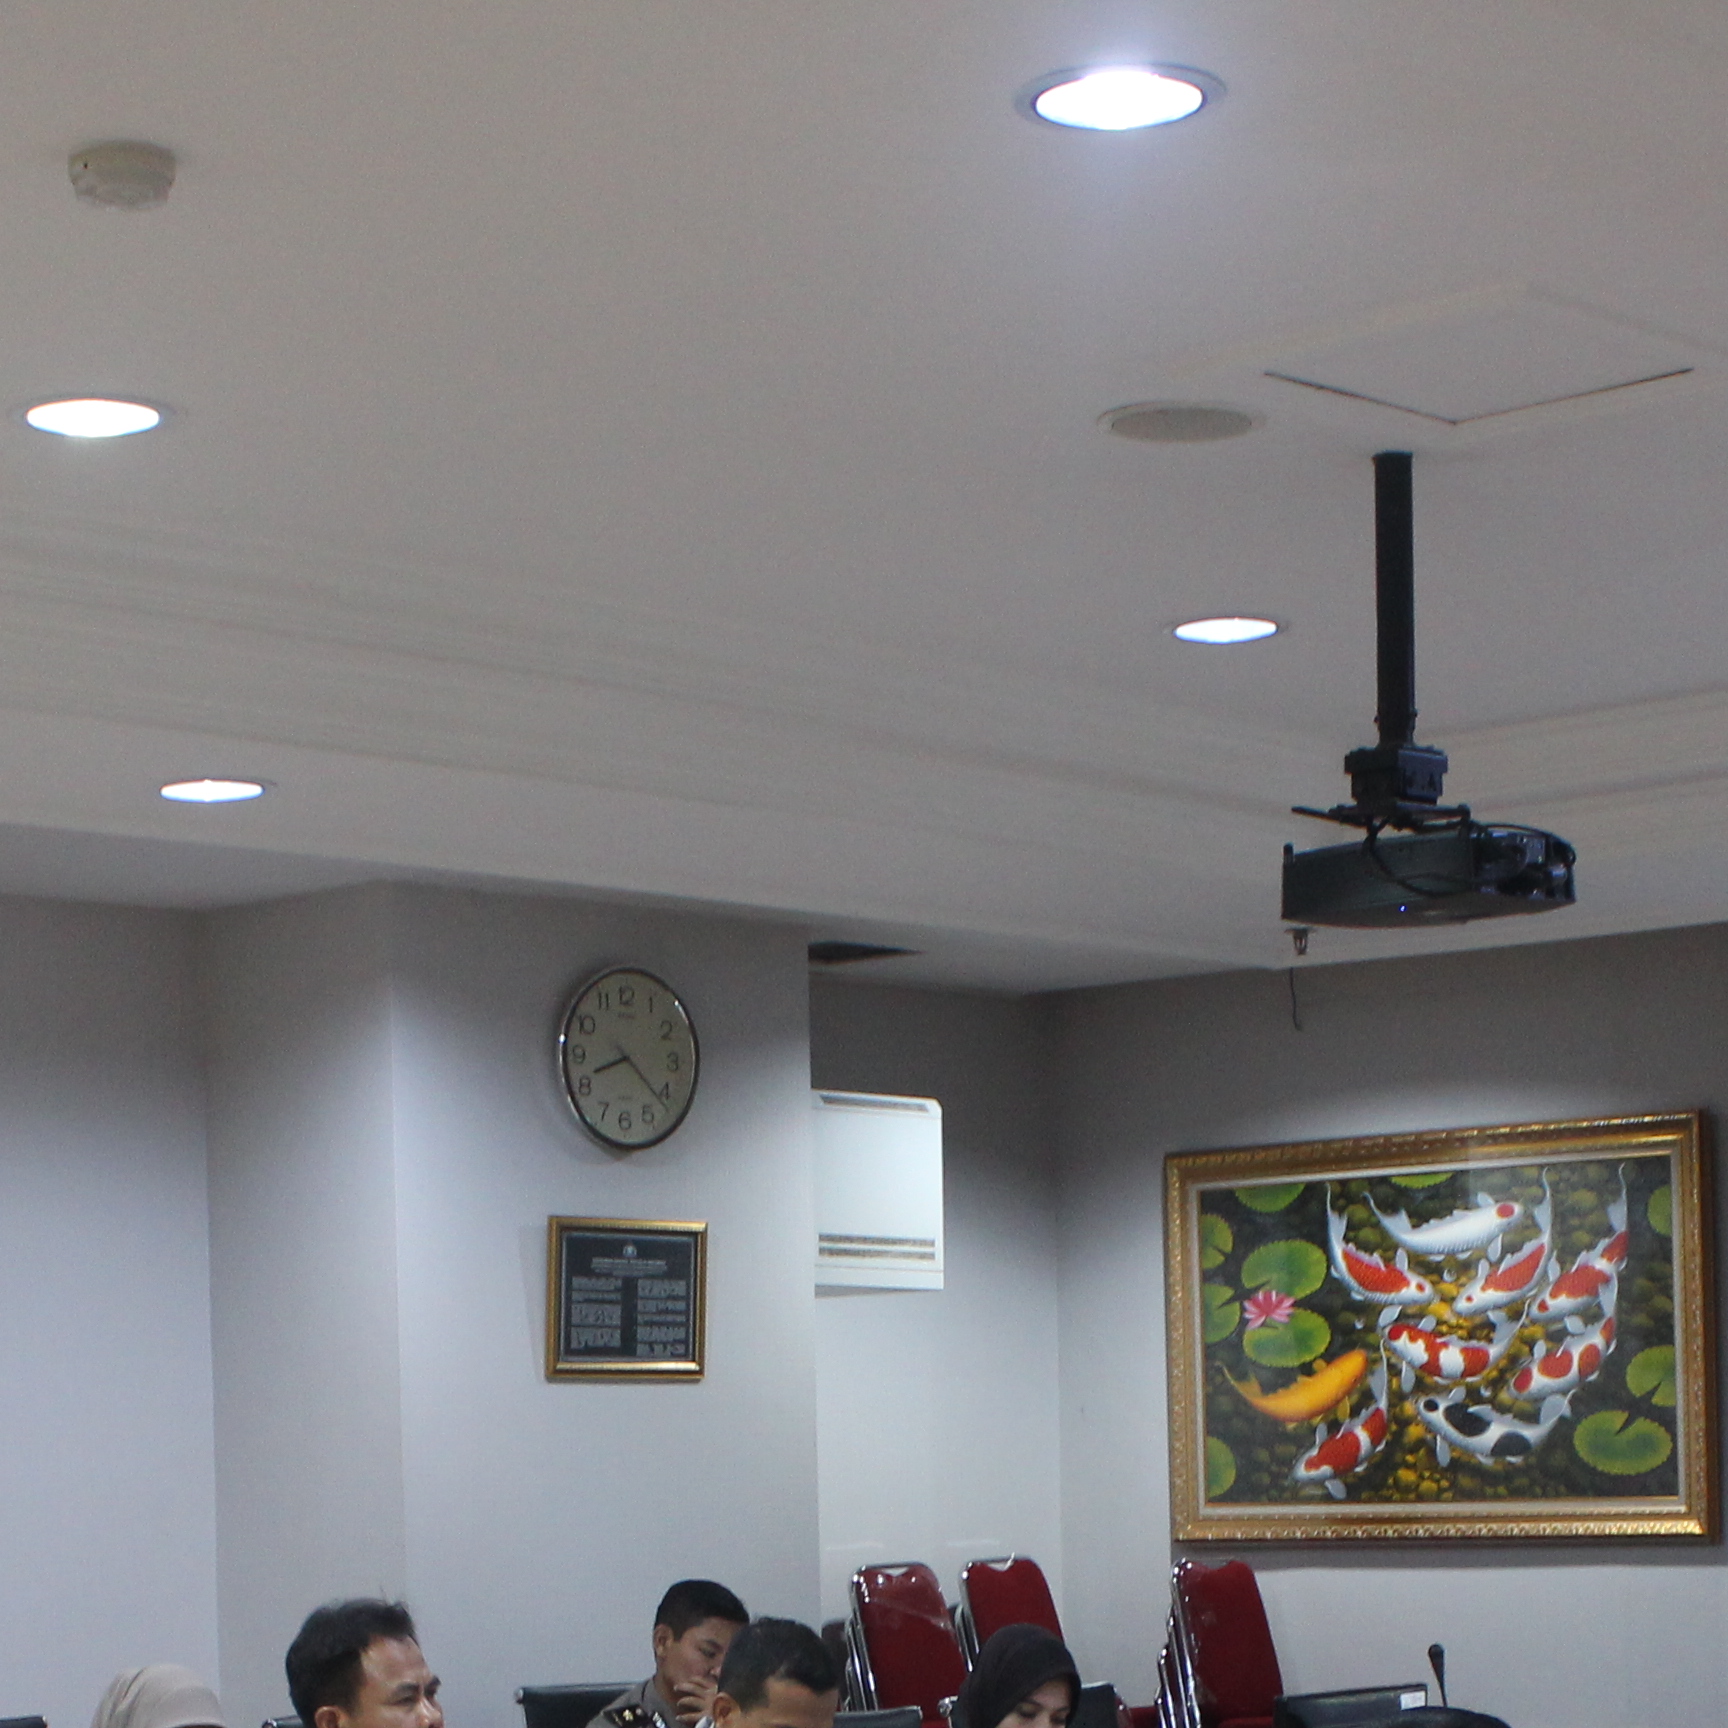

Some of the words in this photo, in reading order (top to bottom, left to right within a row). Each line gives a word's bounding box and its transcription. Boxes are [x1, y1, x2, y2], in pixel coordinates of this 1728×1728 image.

[598, 992, 609, 1010] 11
[619, 986, 634, 1005] 12
[579, 1015, 596, 1034] 10
[661, 1020, 672, 1040] 2
[573, 1045, 586, 1064] 9
[667, 1052, 678, 1072] 3
[579, 1076, 591, 1096] 8
[659, 1082, 671, 1100] 4
[598, 1102, 609, 1121] 7
[619, 1111, 631, 1130] 6
[642, 1104, 654, 1124] 5
